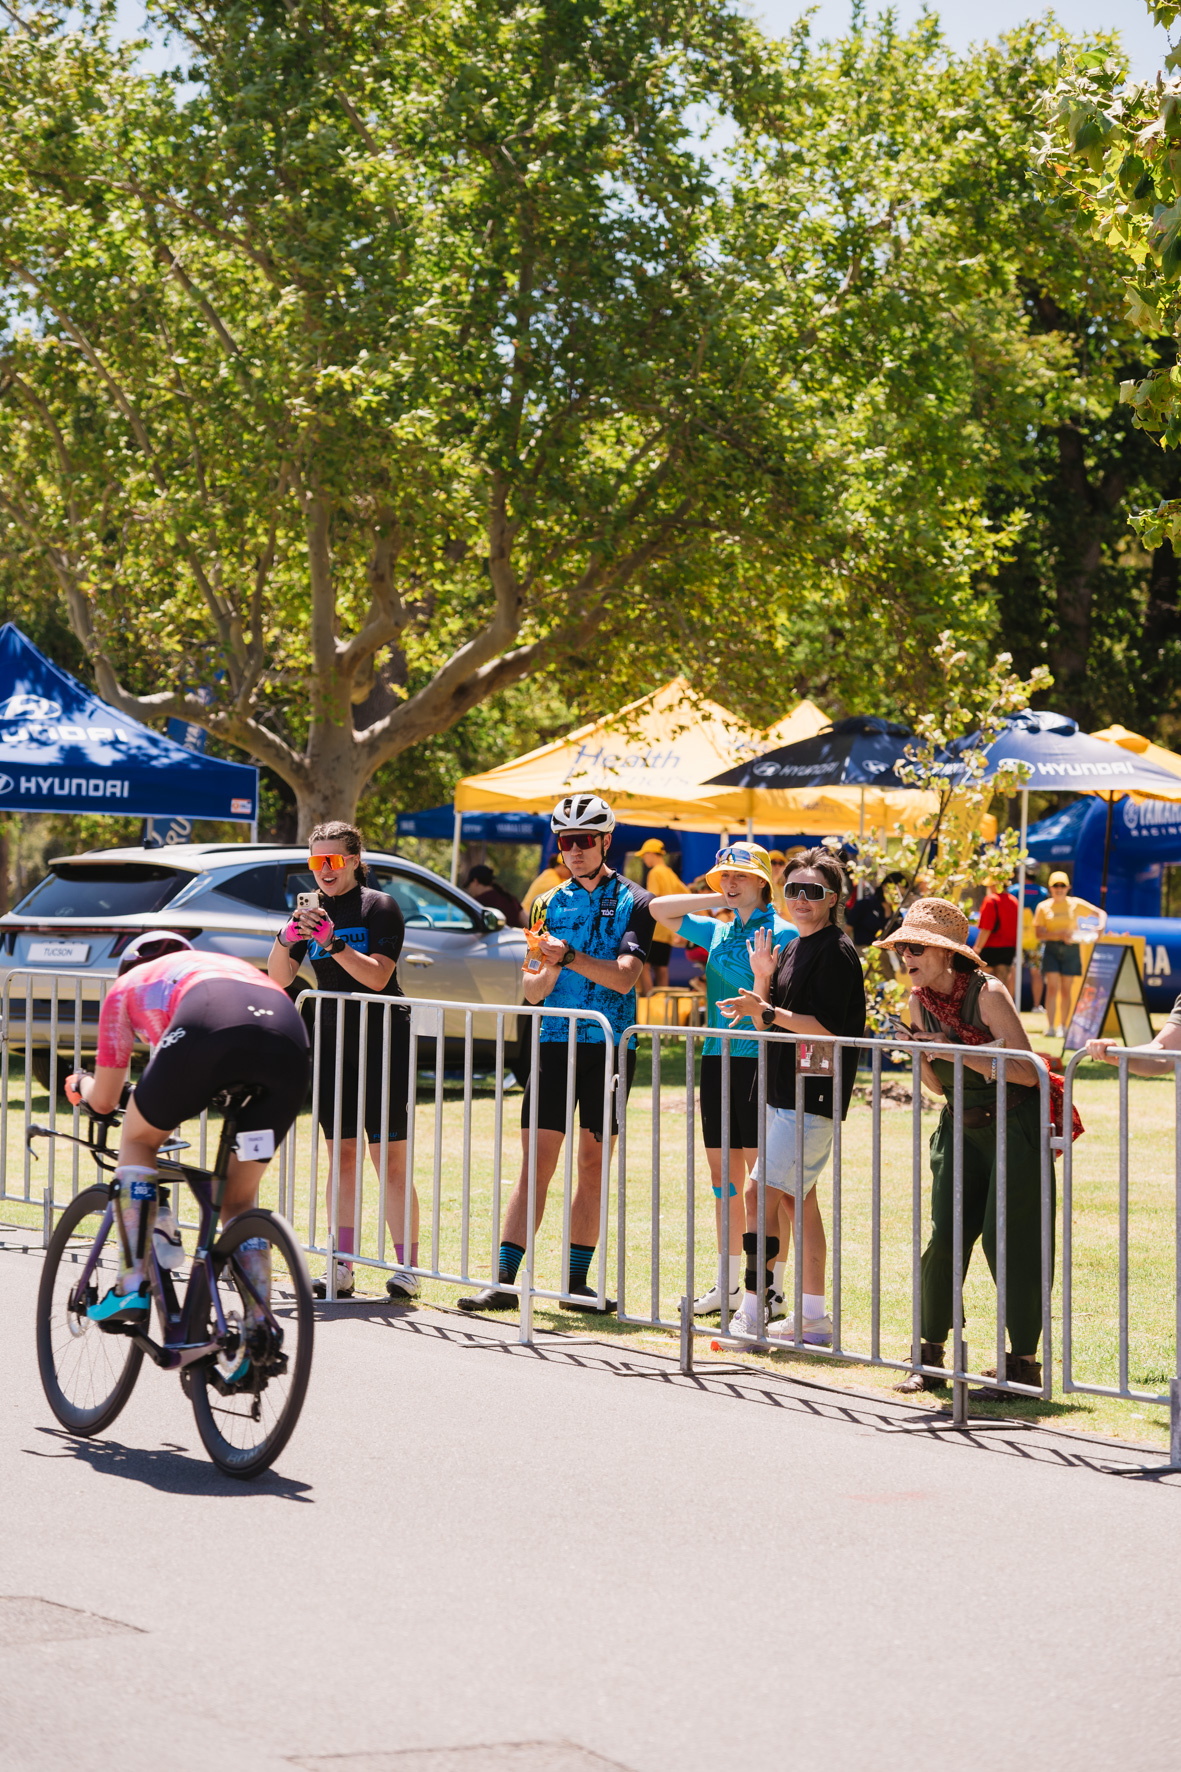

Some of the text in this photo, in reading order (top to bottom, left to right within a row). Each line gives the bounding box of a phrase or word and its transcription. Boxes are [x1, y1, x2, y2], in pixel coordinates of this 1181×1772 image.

[573, 744, 682, 769] Health
[778, 761, 841, 777] HYUNDAI
[1036, 761, 1136, 776] HYUNDAI
[20, 776, 130, 798] HYUNDAI
[43, 947, 73, 957] TUCSON
